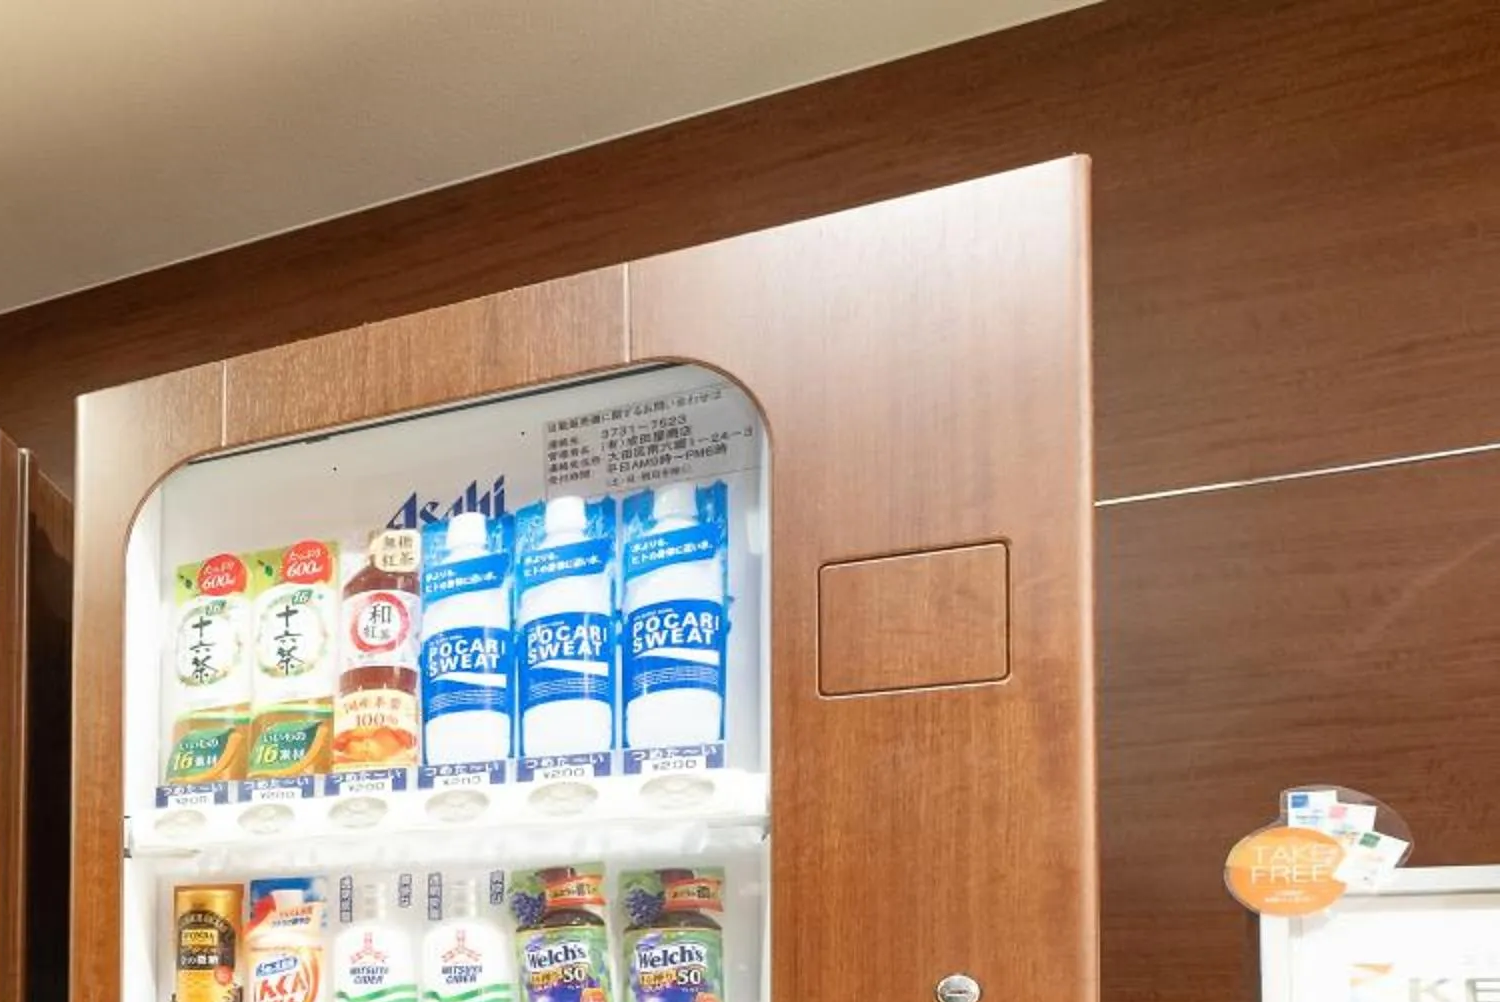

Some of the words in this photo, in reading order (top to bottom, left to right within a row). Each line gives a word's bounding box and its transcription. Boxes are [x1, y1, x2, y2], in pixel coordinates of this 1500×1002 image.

[369, 604, 392, 625] 和
[633, 611, 720, 637] POCARI
[273, 605, 305, 676] 十六茶
[429, 638, 505, 662] POCARI
[527, 624, 607, 651] POCARI
[632, 628, 714, 654] SWEAT
[189, 616, 218, 685] 十六茶
[526, 640, 602, 665] SWEAT
[428, 653, 501, 679] SWEAT
[1253, 845, 1329, 866] TAKE
[1251, 864, 1328, 886] FREE
[527, 944, 586, 969] Welch's
[638, 942, 704, 968] Welch's
[677, 968, 701, 985] 50
